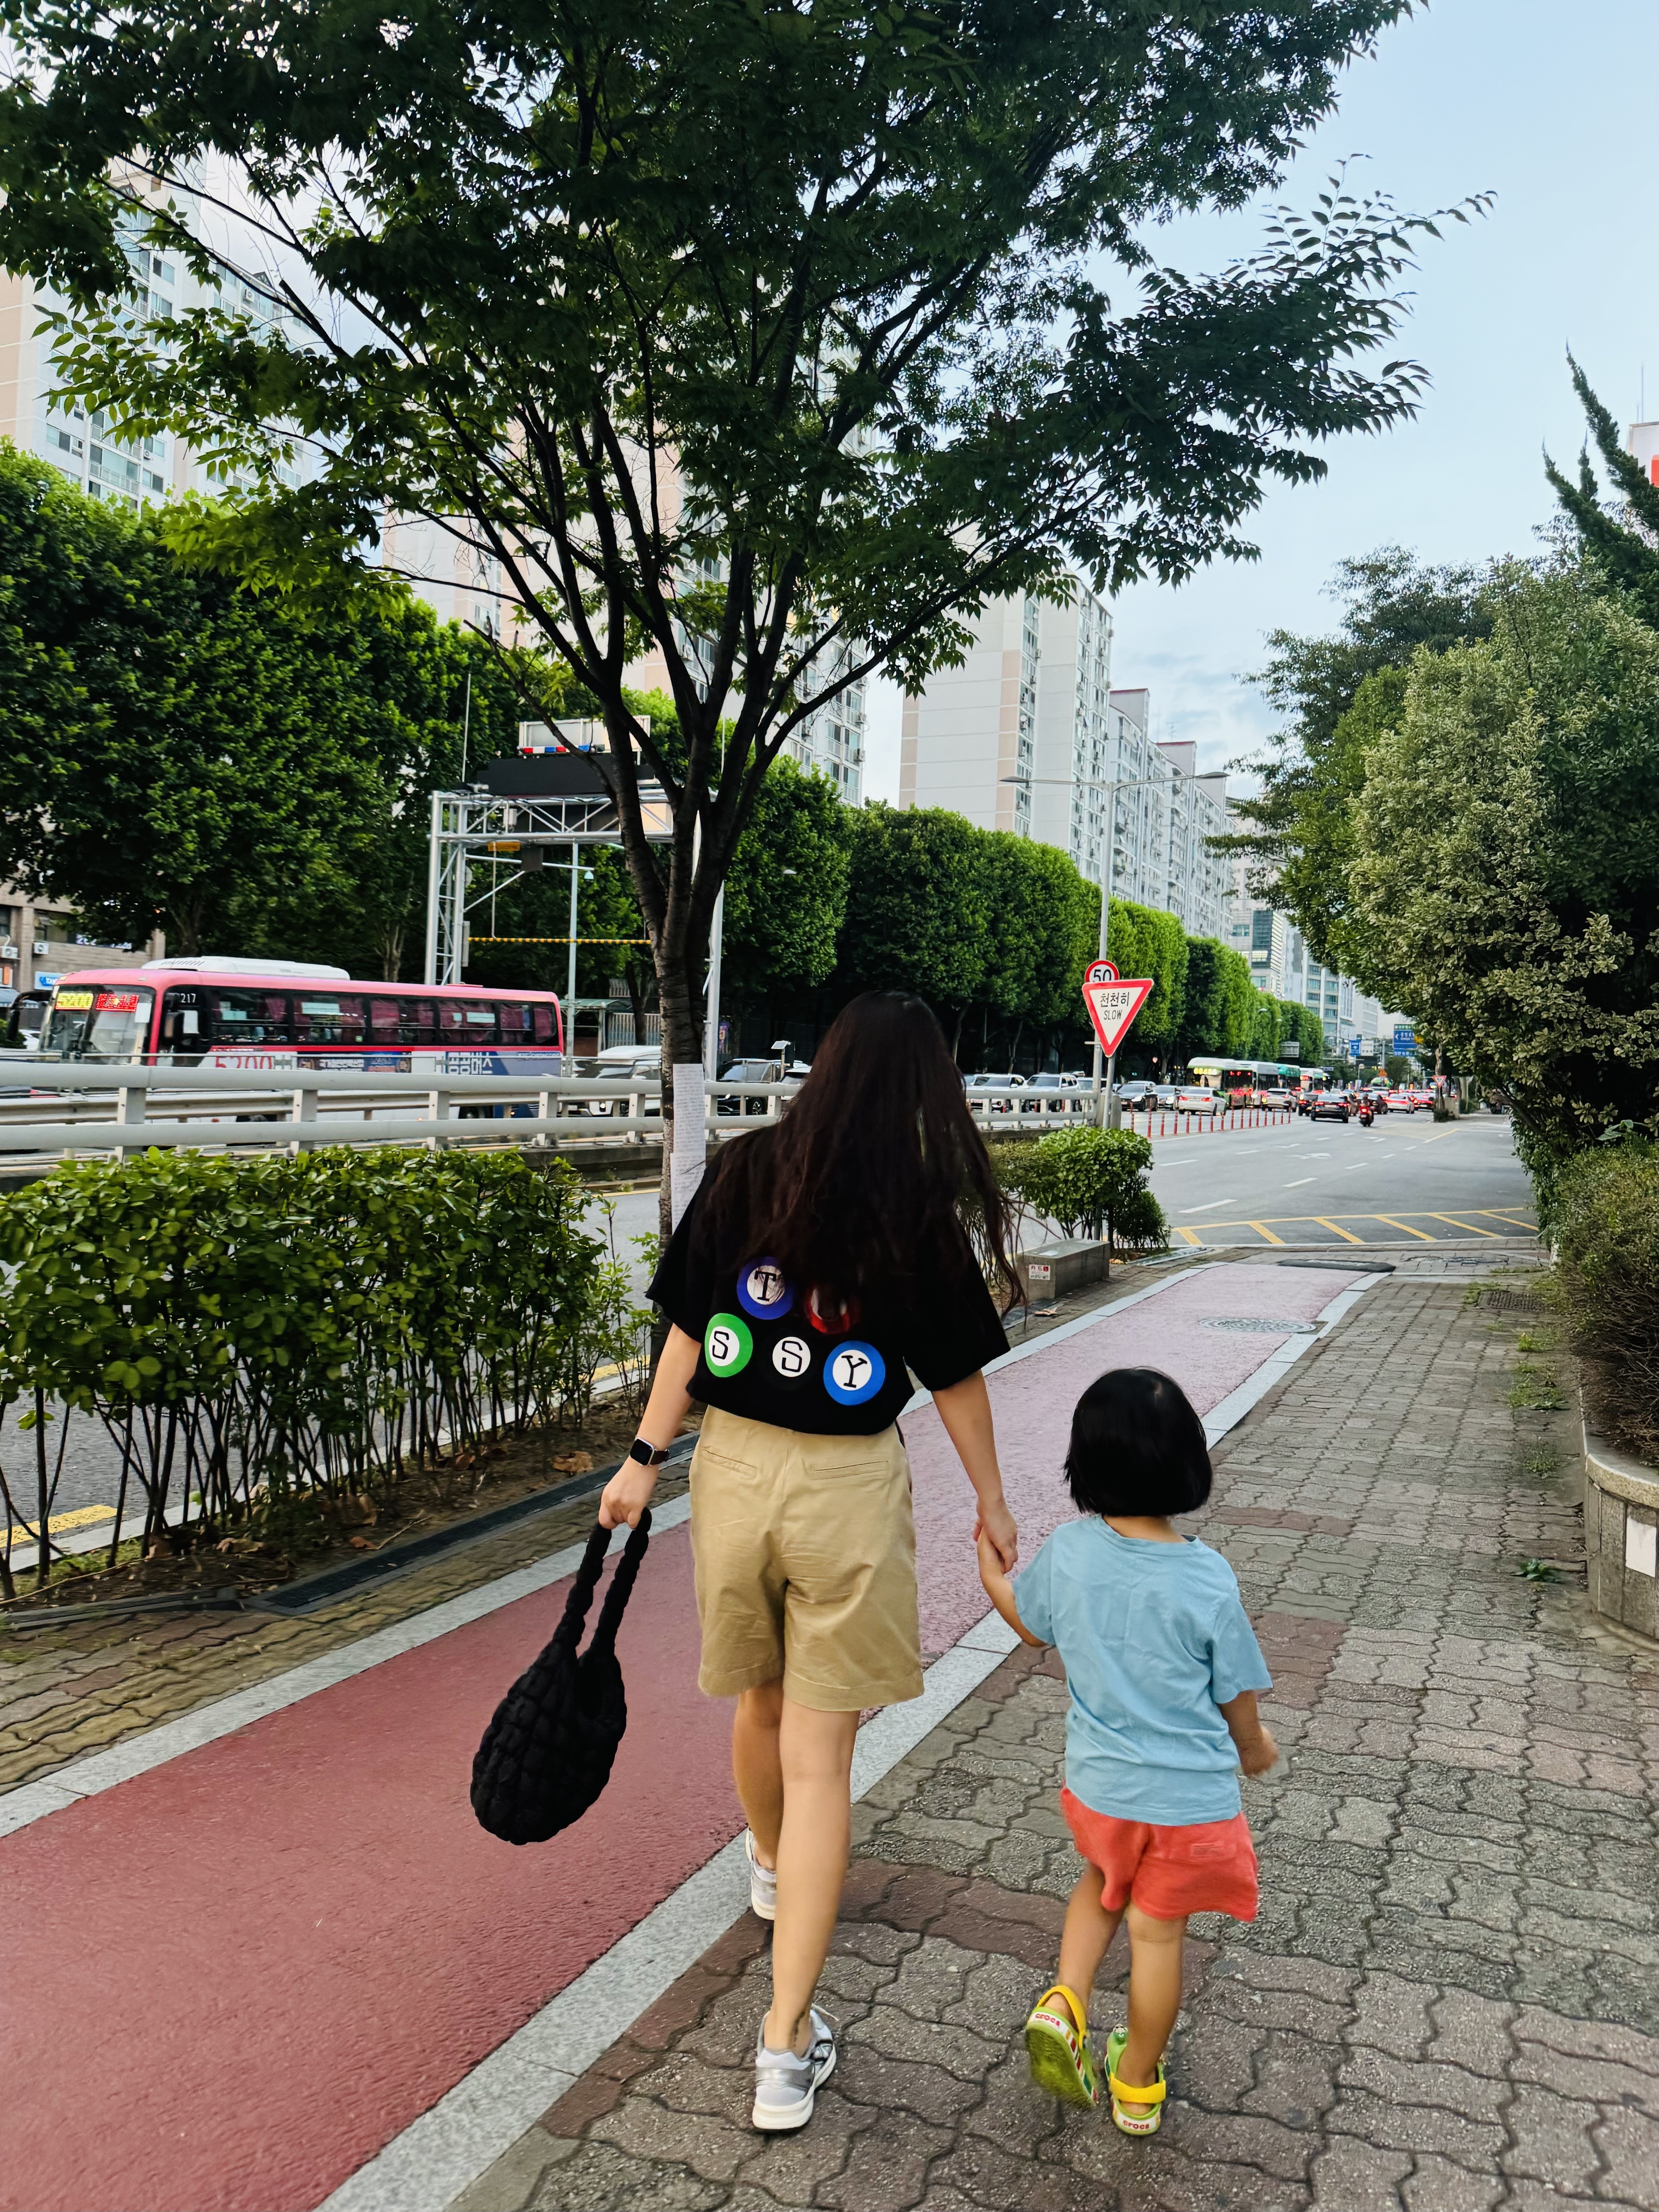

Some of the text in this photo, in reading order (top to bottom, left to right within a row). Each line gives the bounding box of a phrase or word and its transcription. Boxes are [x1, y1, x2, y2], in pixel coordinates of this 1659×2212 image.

[1093, 969, 1112, 982] 50
[1100, 992, 1129, 1007] 천천히
[1104, 1010, 1122, 1020] SLOW
[754, 1271, 777, 1301] T
[1035, 2013, 1060, 2026] crocs
[1123, 2120, 1149, 2129] crocs
